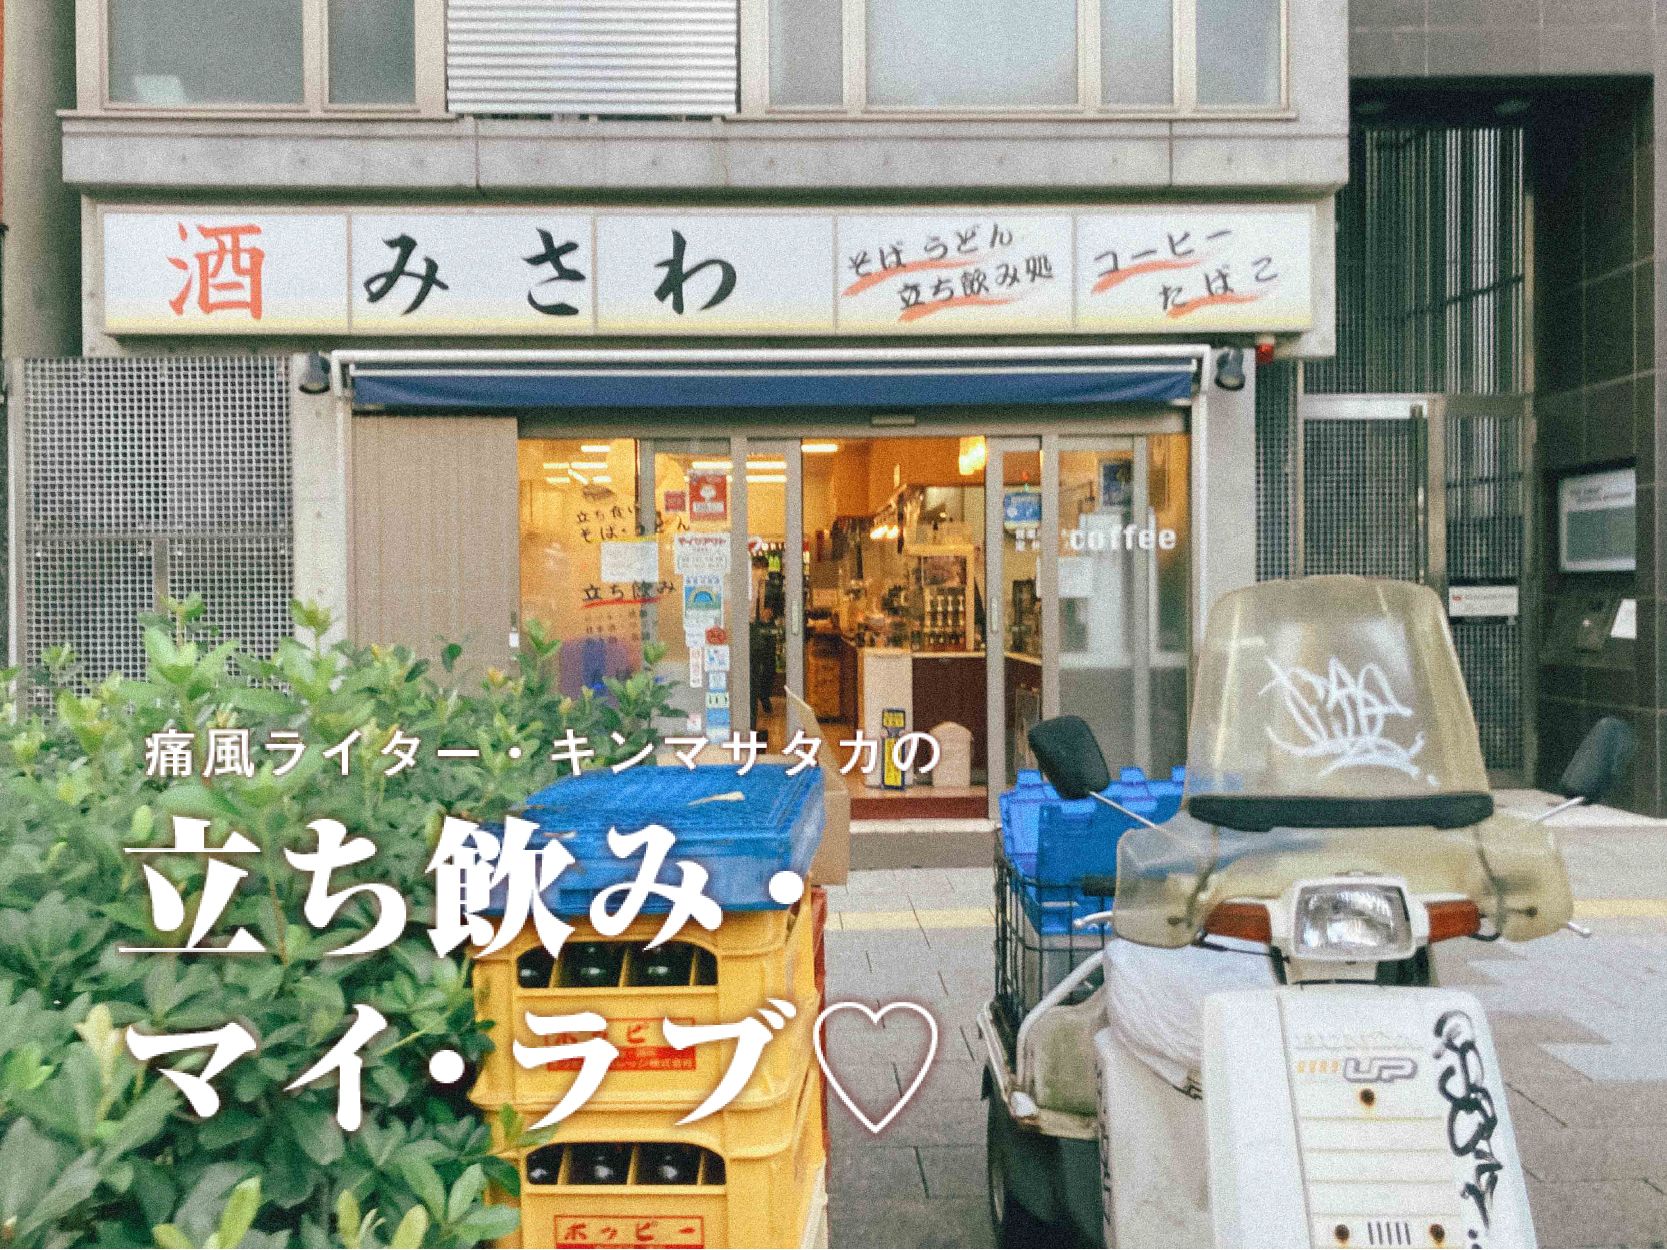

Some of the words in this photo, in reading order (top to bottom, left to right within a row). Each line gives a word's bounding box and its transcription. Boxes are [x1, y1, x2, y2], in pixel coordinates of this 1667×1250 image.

[167, 222, 266, 321] 酒
[364, 229, 737, 316] みさわ
[1094, 229, 1232, 278] コーヒー
[898, 253, 1054, 309] 立ち飲み処
[1159, 263, 1278, 310] たばこ
[1068, 523, 1177, 551] coffee
[1343, 1056, 1419, 1084] UP
[563, 1220, 697, 1242] ホッピー
